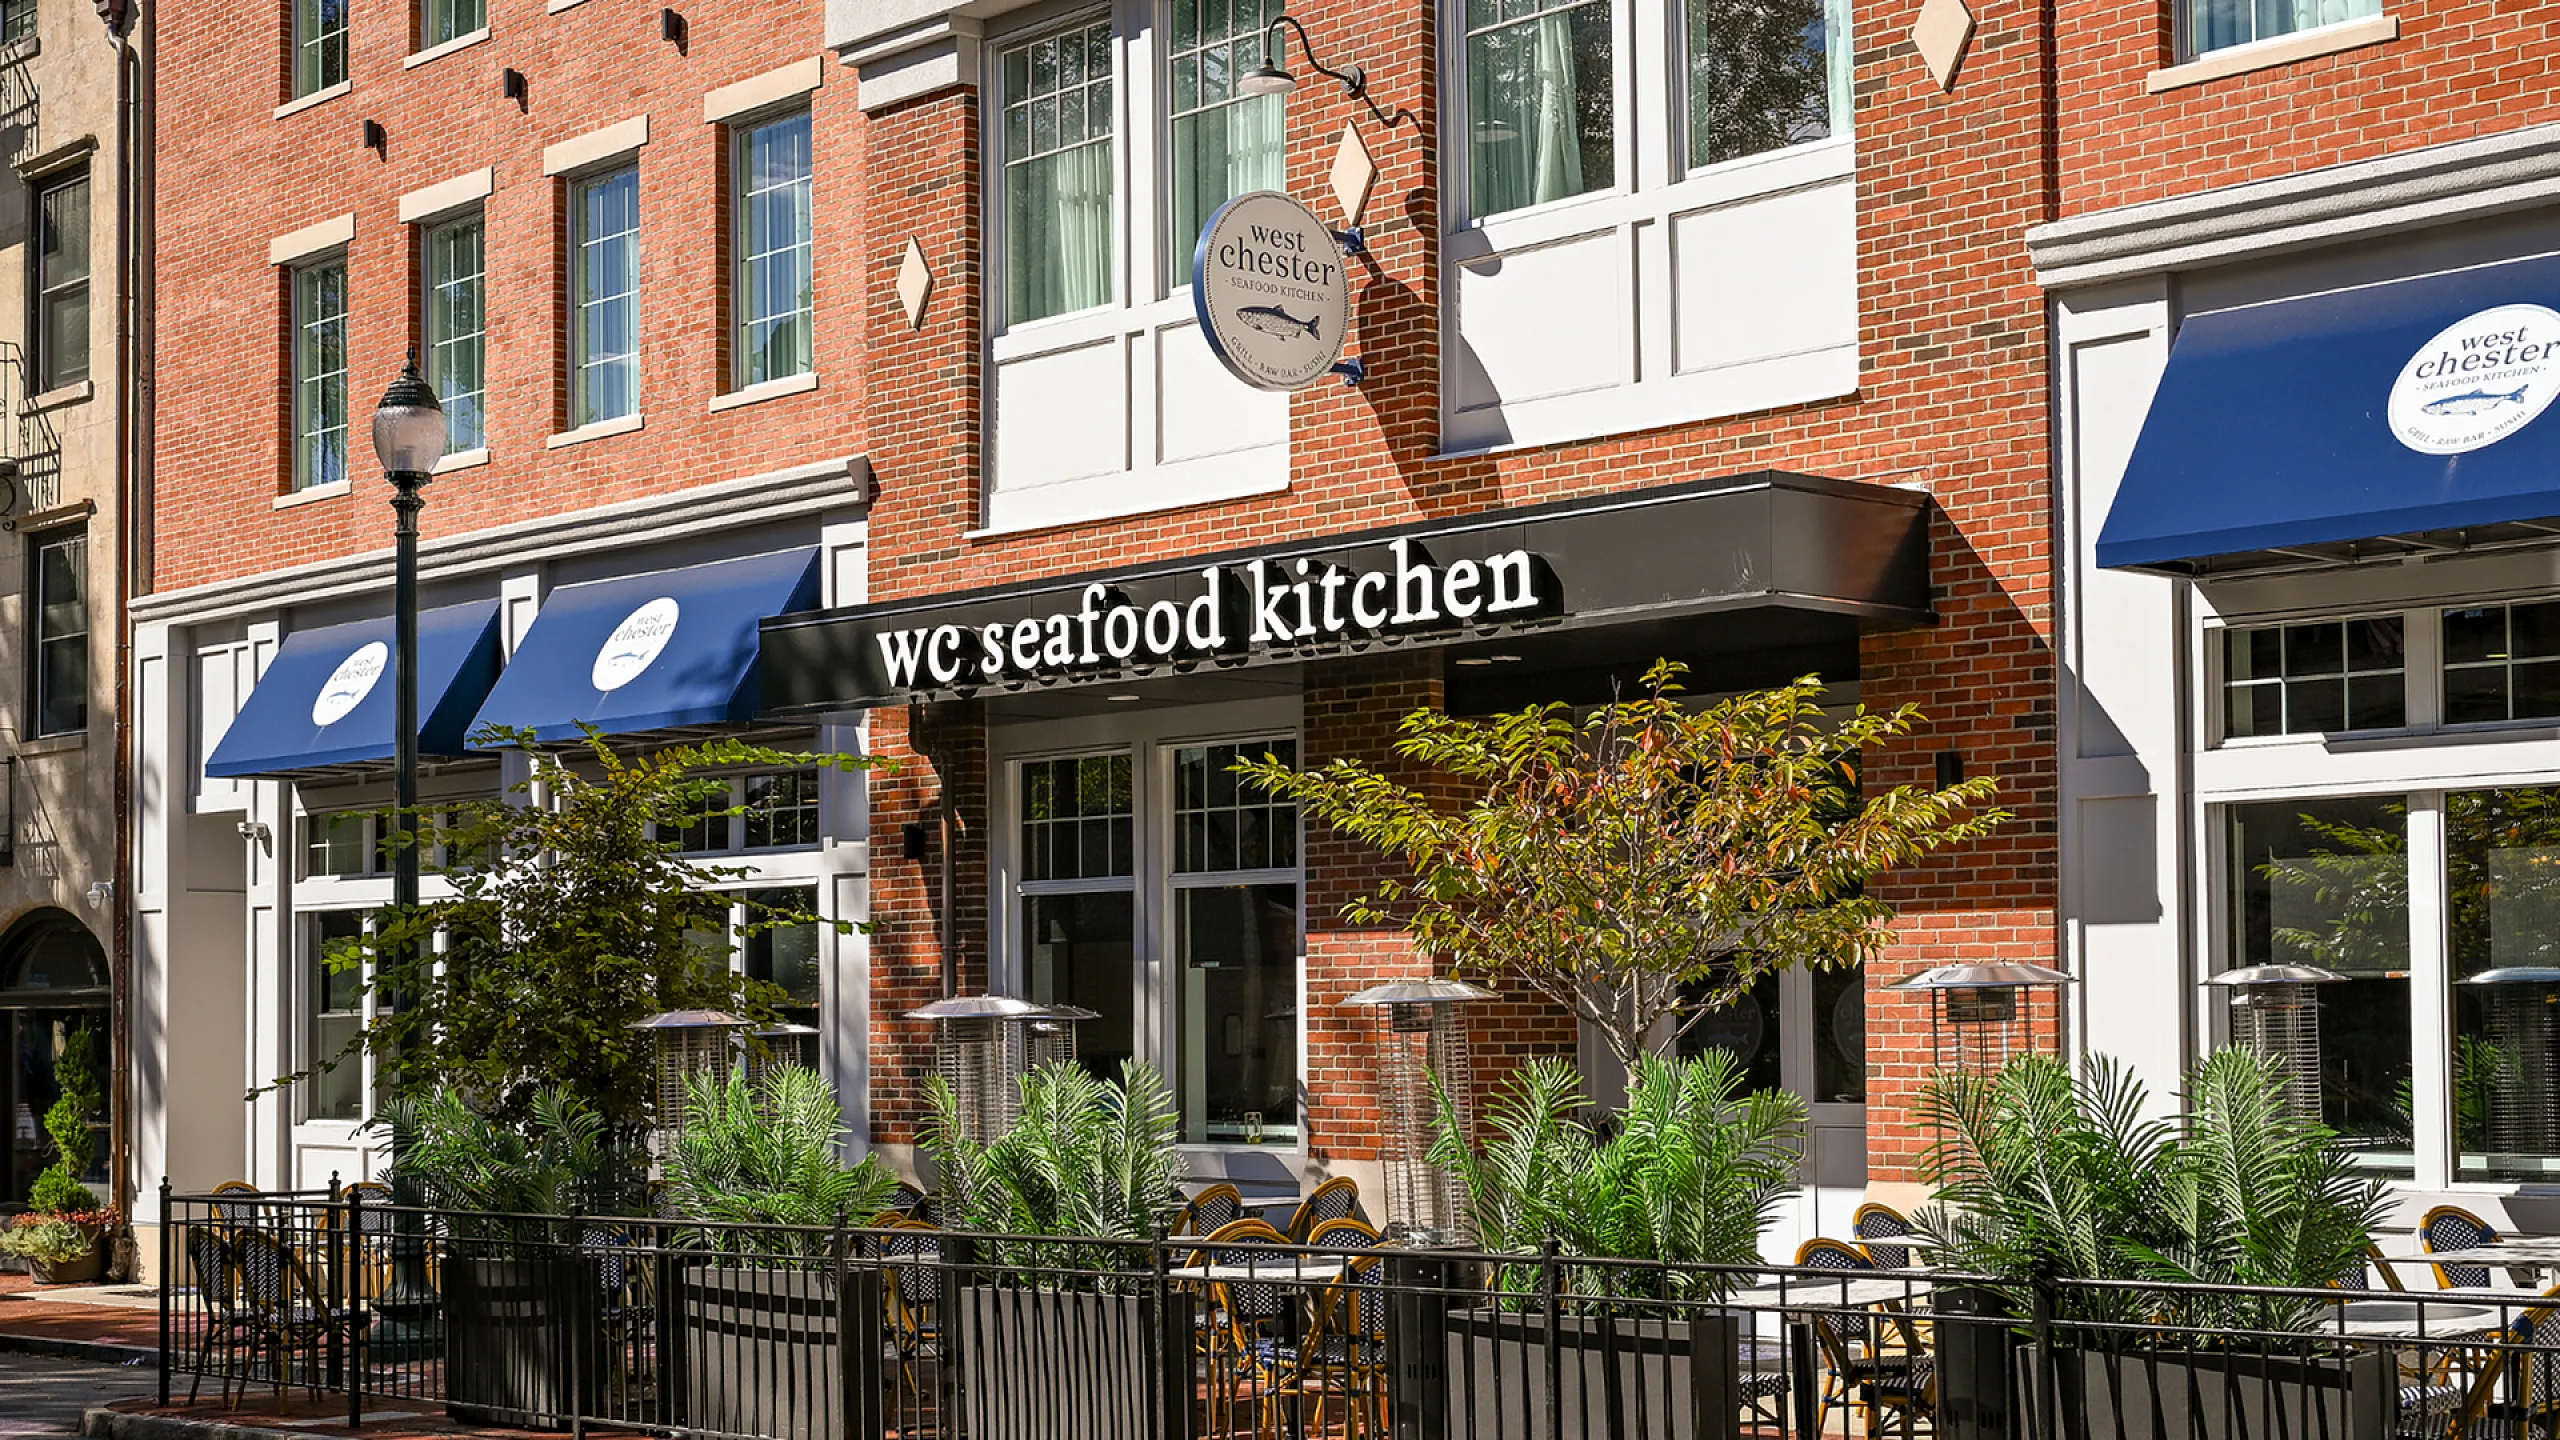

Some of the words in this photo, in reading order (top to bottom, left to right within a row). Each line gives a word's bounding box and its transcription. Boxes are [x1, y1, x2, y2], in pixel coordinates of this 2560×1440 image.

[1250, 224, 1305, 253] west
[1219, 236, 1335, 286] chester
[1231, 276, 1278, 294] SEAFOOD
[1280, 286, 1325, 302] KITCHEN
[2461, 325, 2529, 352] west
[1231, 336, 1254, 362] GRILL
[1259, 362, 1278, 376] RAW
[1303, 350, 1327, 373] SUSHI
[2415, 341, 2560, 380] chester
[2422, 375, 2480, 392] SEAFOOD
[2483, 364, 2541, 382] KITCHEN
[2407, 425, 2431, 444] GRILL
[2463, 431, 2486, 445] BAR
[876, 624, 961, 688] wc
[980, 565, 1226, 675] seafood
[1246, 537, 1539, 642] kitchen
[614, 624, 672, 642] chester
